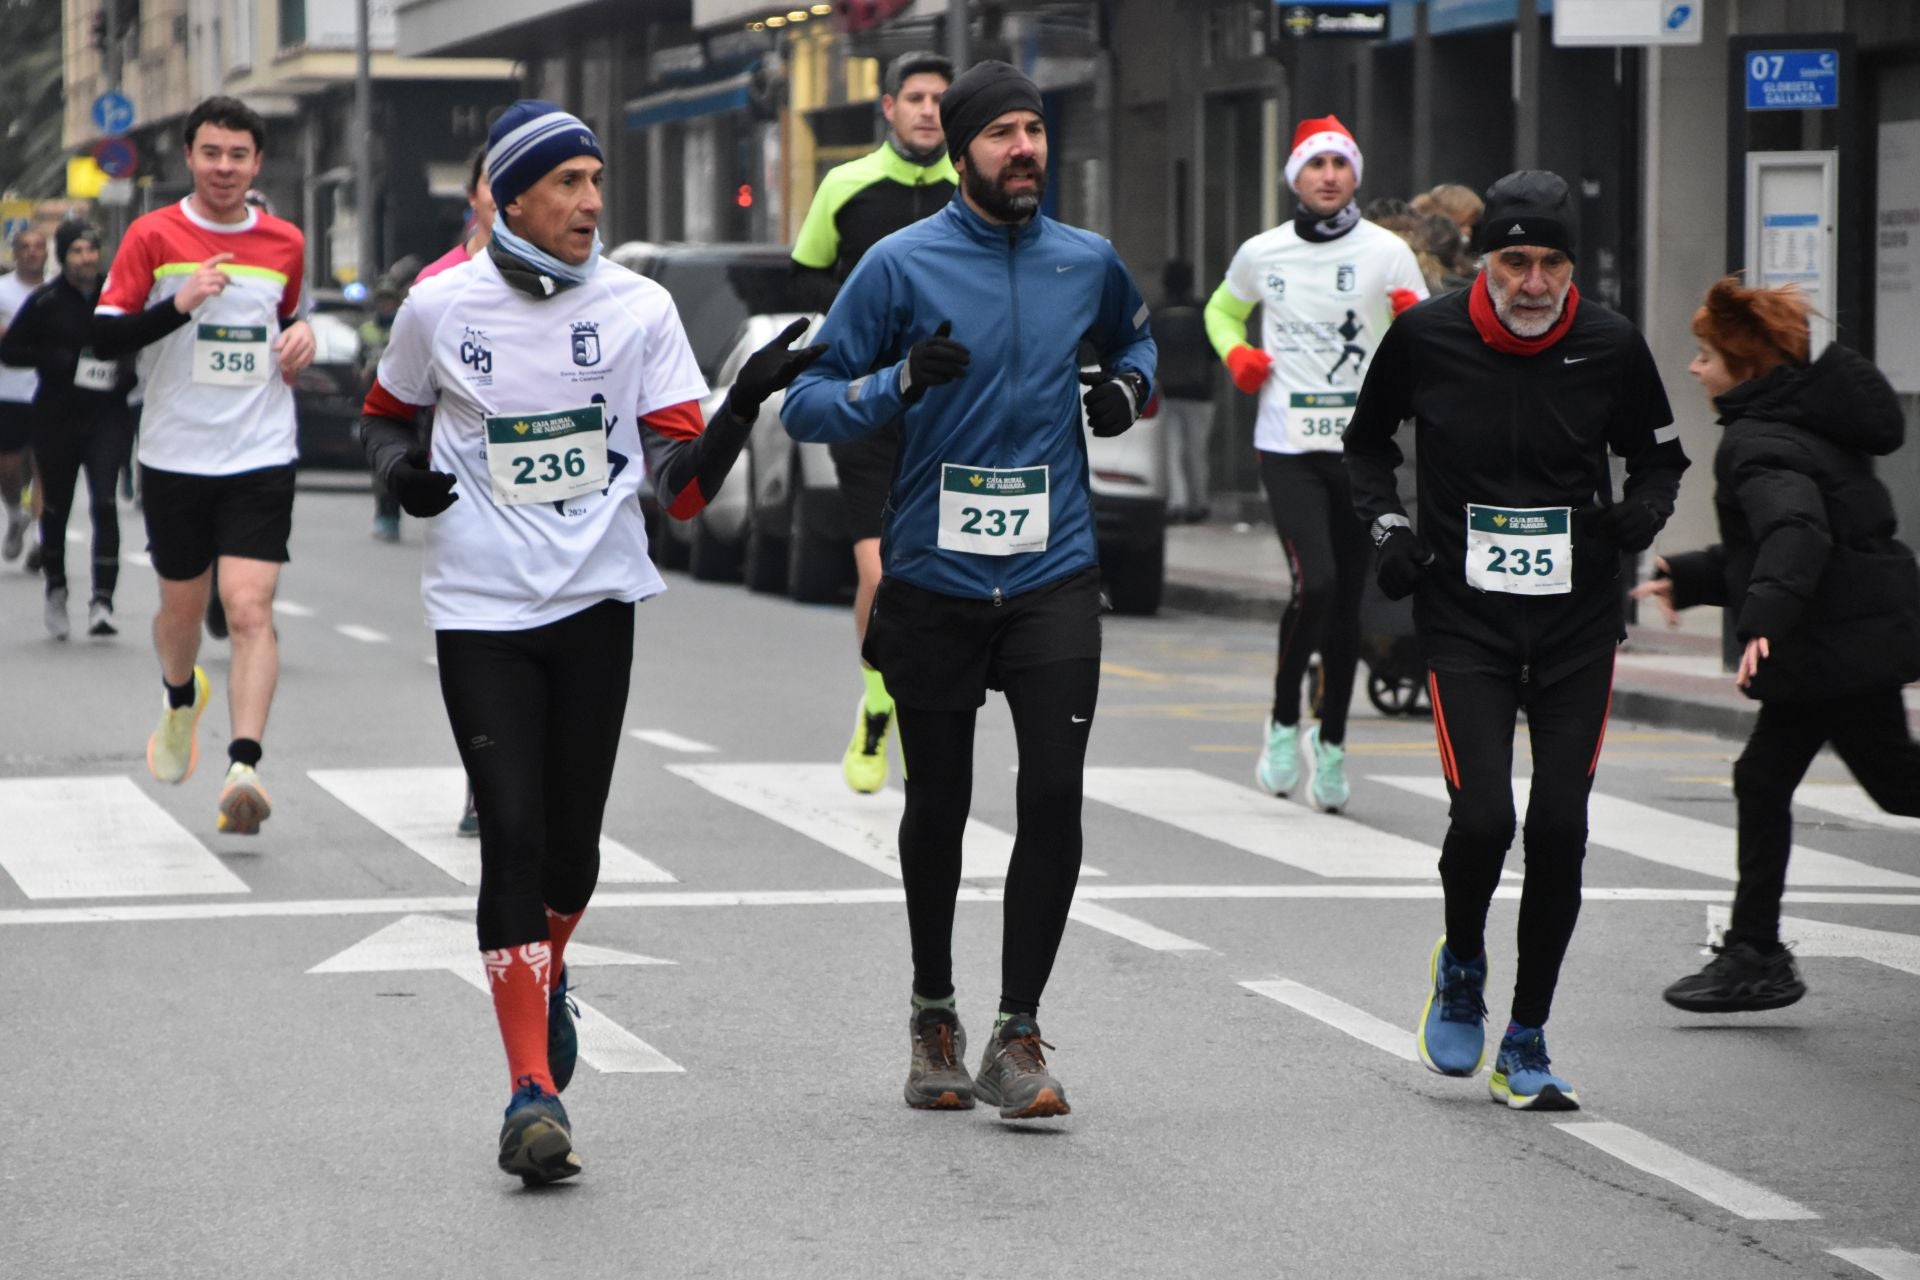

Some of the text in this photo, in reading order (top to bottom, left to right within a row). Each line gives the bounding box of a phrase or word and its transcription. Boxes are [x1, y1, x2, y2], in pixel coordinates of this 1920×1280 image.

[1751, 56, 1784, 81] 07
[210, 351, 256, 372] 358
[460, 341, 493, 374] CPJ
[531, 416, 572, 428] CAJA RURAL
[544, 421, 576, 433] NAVARRA
[1302, 417, 1347, 436] 385
[511, 447, 586, 485] 236
[960, 507, 1030, 537] 237
[1486, 545, 1554, 576] 235
